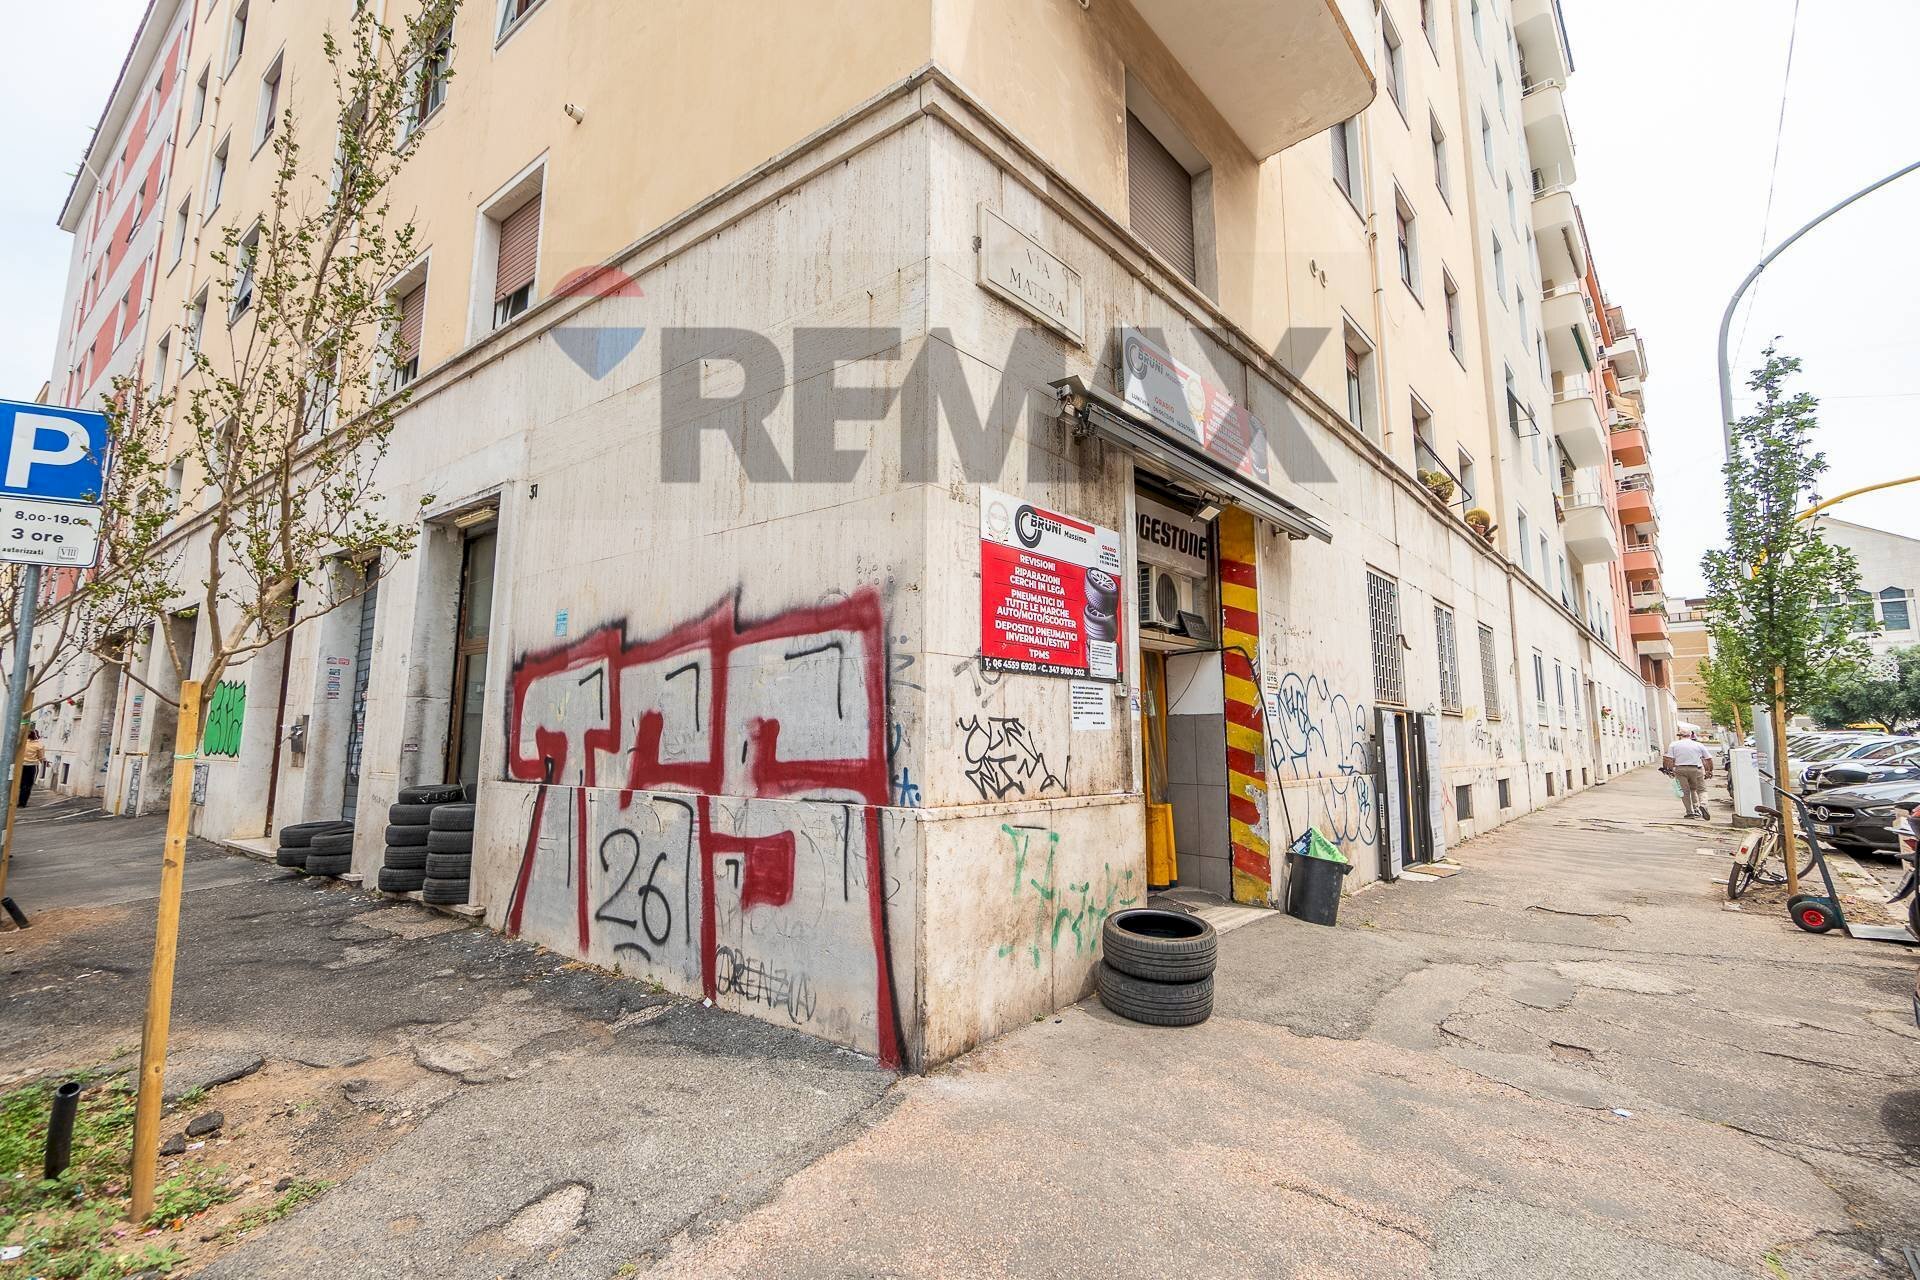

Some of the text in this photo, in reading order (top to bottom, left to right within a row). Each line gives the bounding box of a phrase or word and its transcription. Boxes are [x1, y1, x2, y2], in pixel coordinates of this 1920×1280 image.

[1025, 249, 1050, 280] VIA
[1009, 267, 1064, 317] MATERA
[1138, 351, 1163, 374] BRUNI
[5, 411, 91, 488] P
[1031, 514, 1062, 535] BRUNI
[11, 528, 64, 543] 3 ore
[1136, 512, 1208, 560] GESTONE
[1020, 554, 1056, 571] REVISIONI
[1009, 575, 1065, 595] CERCHI IN LEGA
[1015, 566, 1060, 586] RIPARAZIONI
[1005, 597, 1069, 618] TUTTE LE MARCHE
[1011, 589, 1064, 608] PNEUMATICI DI
[997, 606, 1076, 628] AUTO/MOTO/SCOOTER
[995, 620, 1078, 641] DEPOSITO PNEUMATICI
[1006, 631, 1069, 649] INVERNALI/ESTIVI
[1029, 649, 1050, 659] TPMS
[993, 659, 1002, 667] 06
[1003, 660, 1019, 669] 4559
[1021, 662, 1036, 671] 6928
[1041, 665, 1048, 673] C.
[1049, 666, 1059, 674] 347
[596, 827, 671, 945] 26
